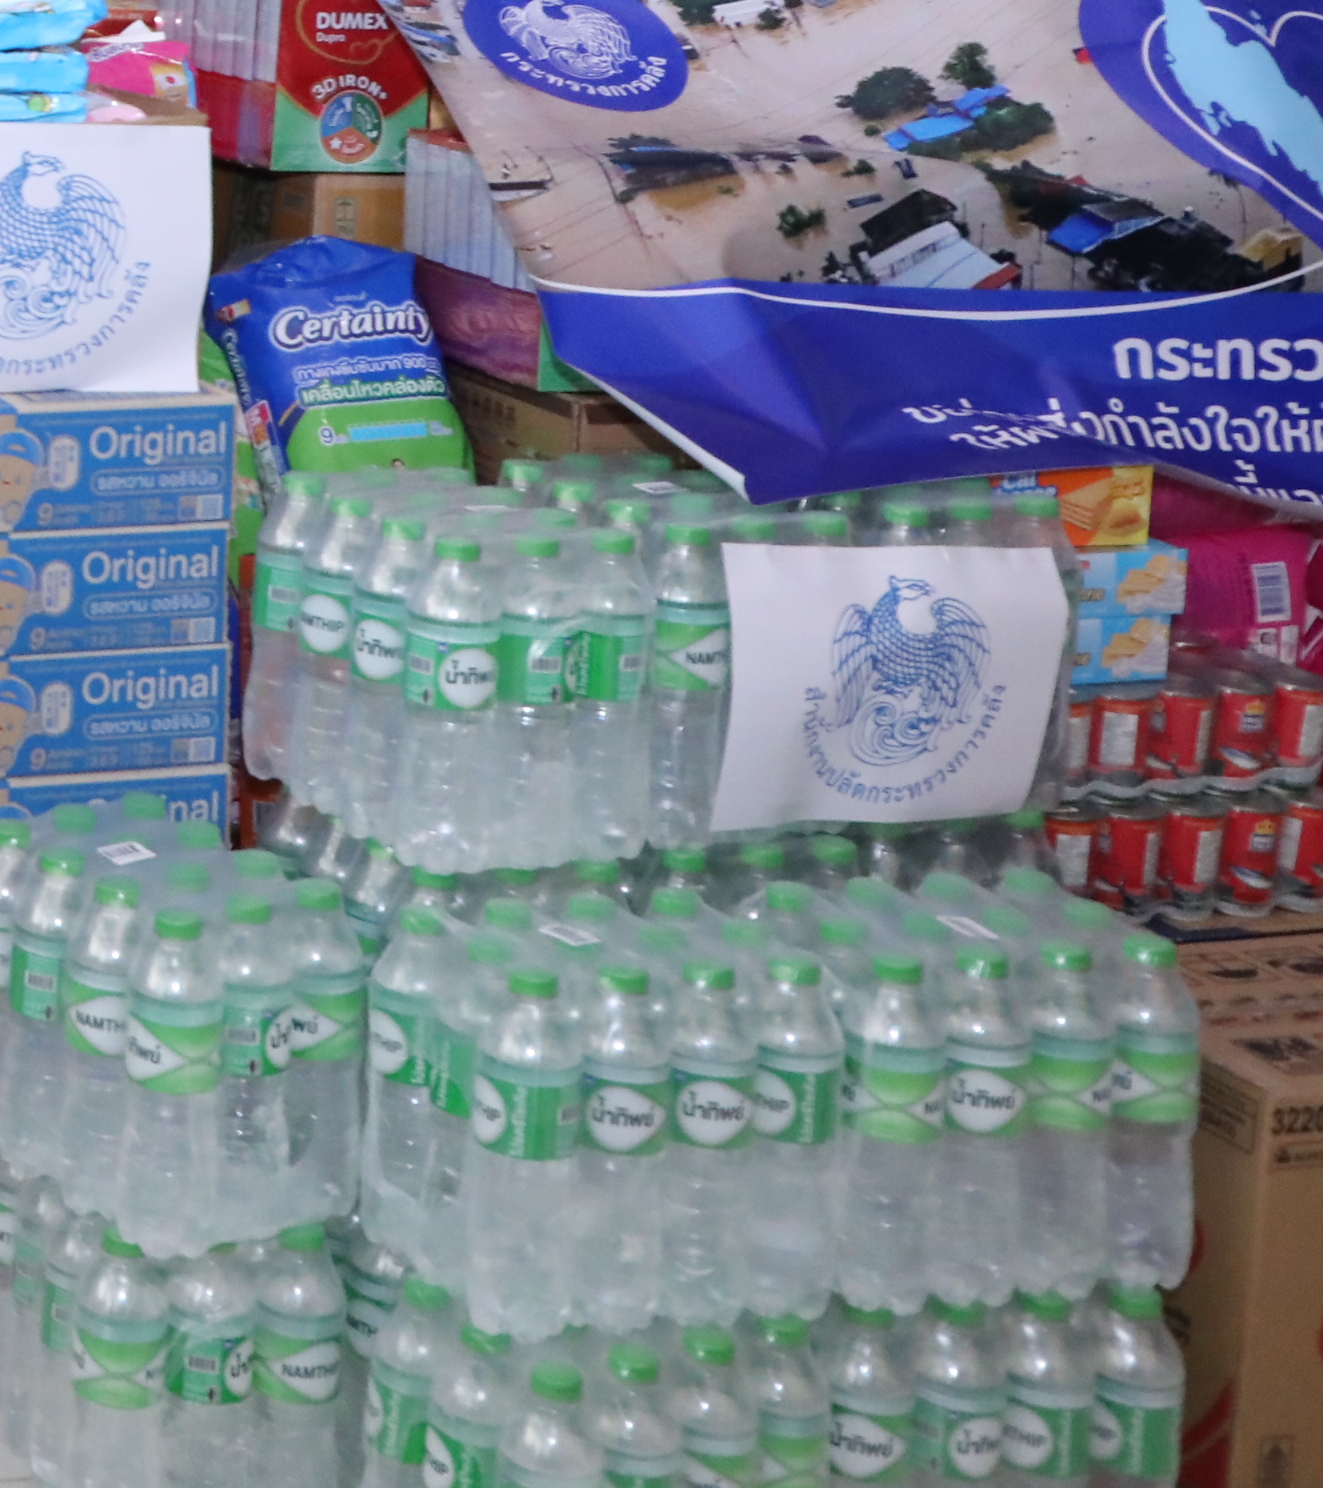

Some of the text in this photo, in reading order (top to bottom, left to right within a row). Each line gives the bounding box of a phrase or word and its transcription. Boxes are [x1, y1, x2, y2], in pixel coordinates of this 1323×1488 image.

[316, 12, 389, 31] DUMEX
[316, 32, 346, 44] Dupro
[500, 52, 667, 97] กระทรวงการคลัง
[273, 302, 433, 347] Certainty
[1112, 337, 1323, 382] กระทรว
[301, 375, 446, 403] เคลื่อนไหวคล่องตัว
[89, 421, 227, 466] Original
[81, 545, 219, 590] Original
[356, 627, 402, 659] น้ำทิพ
[686, 648, 727, 666] NAMT
[82, 664, 220, 709] Original
[445, 659, 496, 686] น้ำทิพ
[804, 684, 1007, 804] สำนักงานปลัดกระทรวงการคลัง
[75, 1009, 129, 1034] NAMTH
